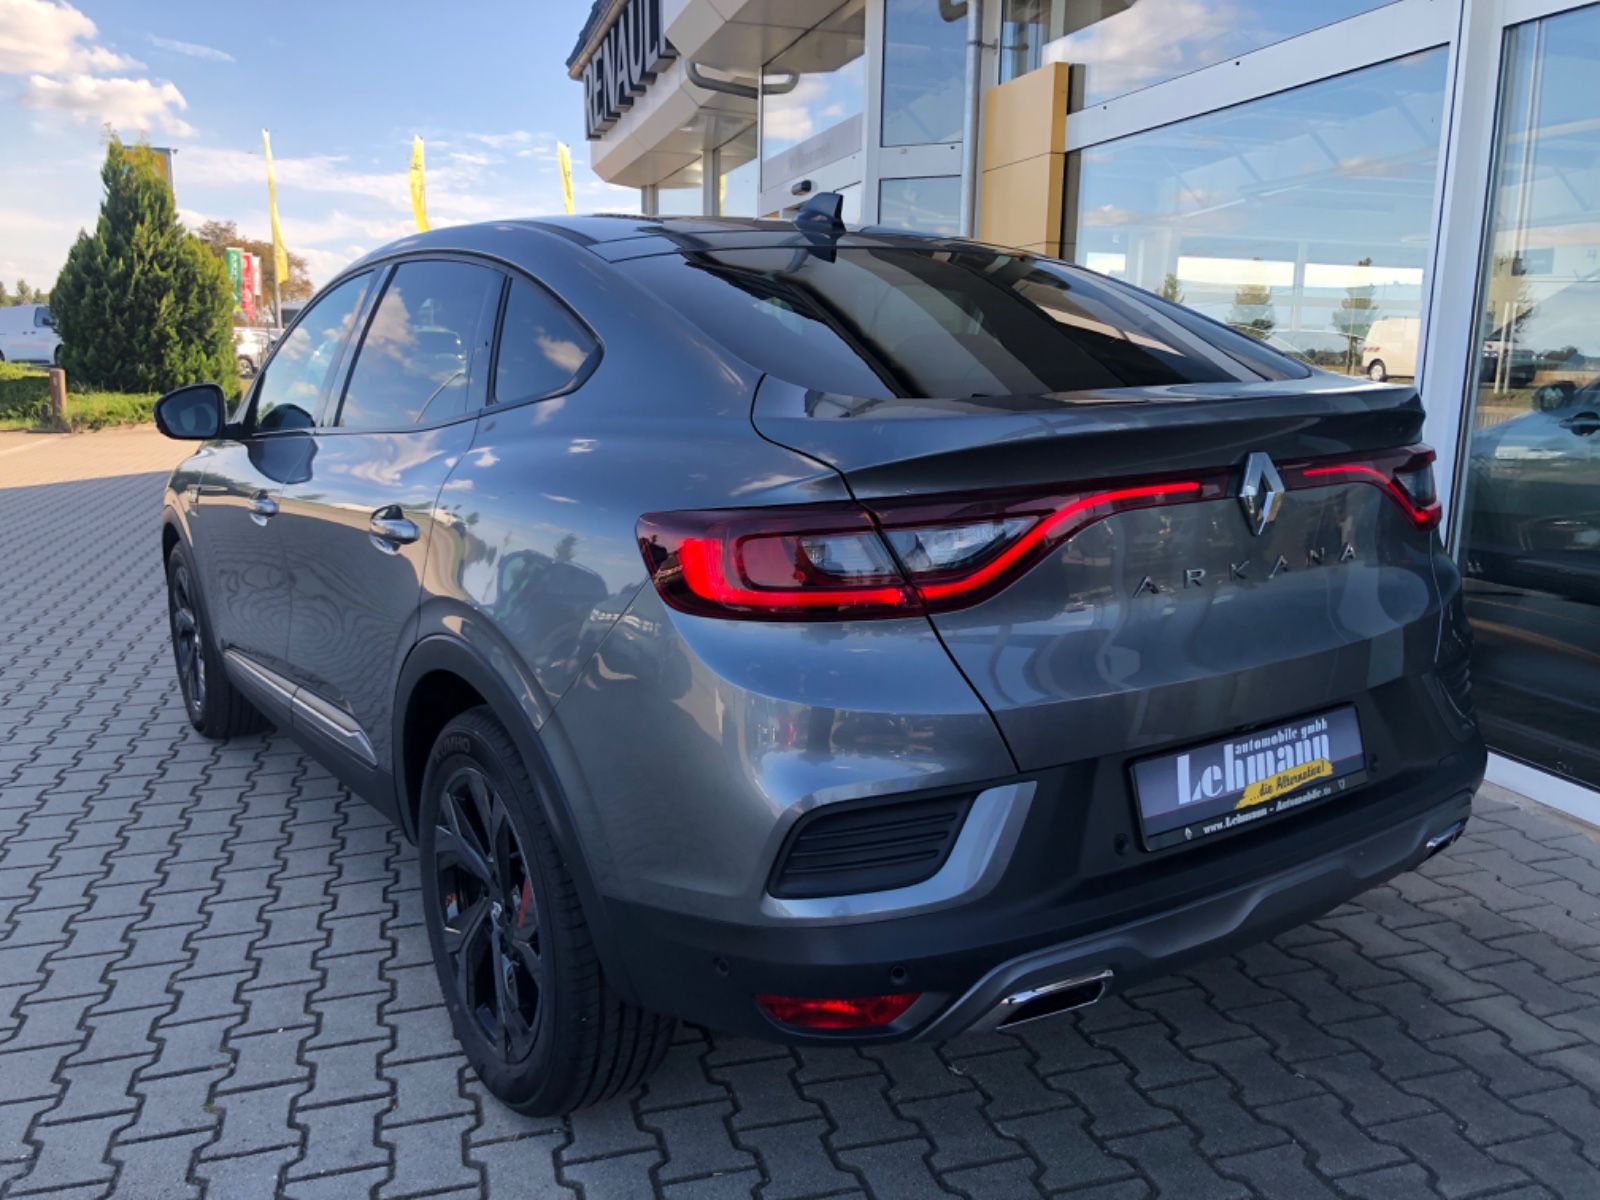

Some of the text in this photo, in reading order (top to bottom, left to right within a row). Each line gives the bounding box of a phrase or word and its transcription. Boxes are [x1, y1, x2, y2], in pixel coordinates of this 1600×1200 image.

[1133, 542, 1357, 598] ARKANA
[1234, 717, 1328, 755] automobile gmbh
[1176, 734, 1330, 805] Lehmann
[1276, 761, 1325, 790] Alternative!
